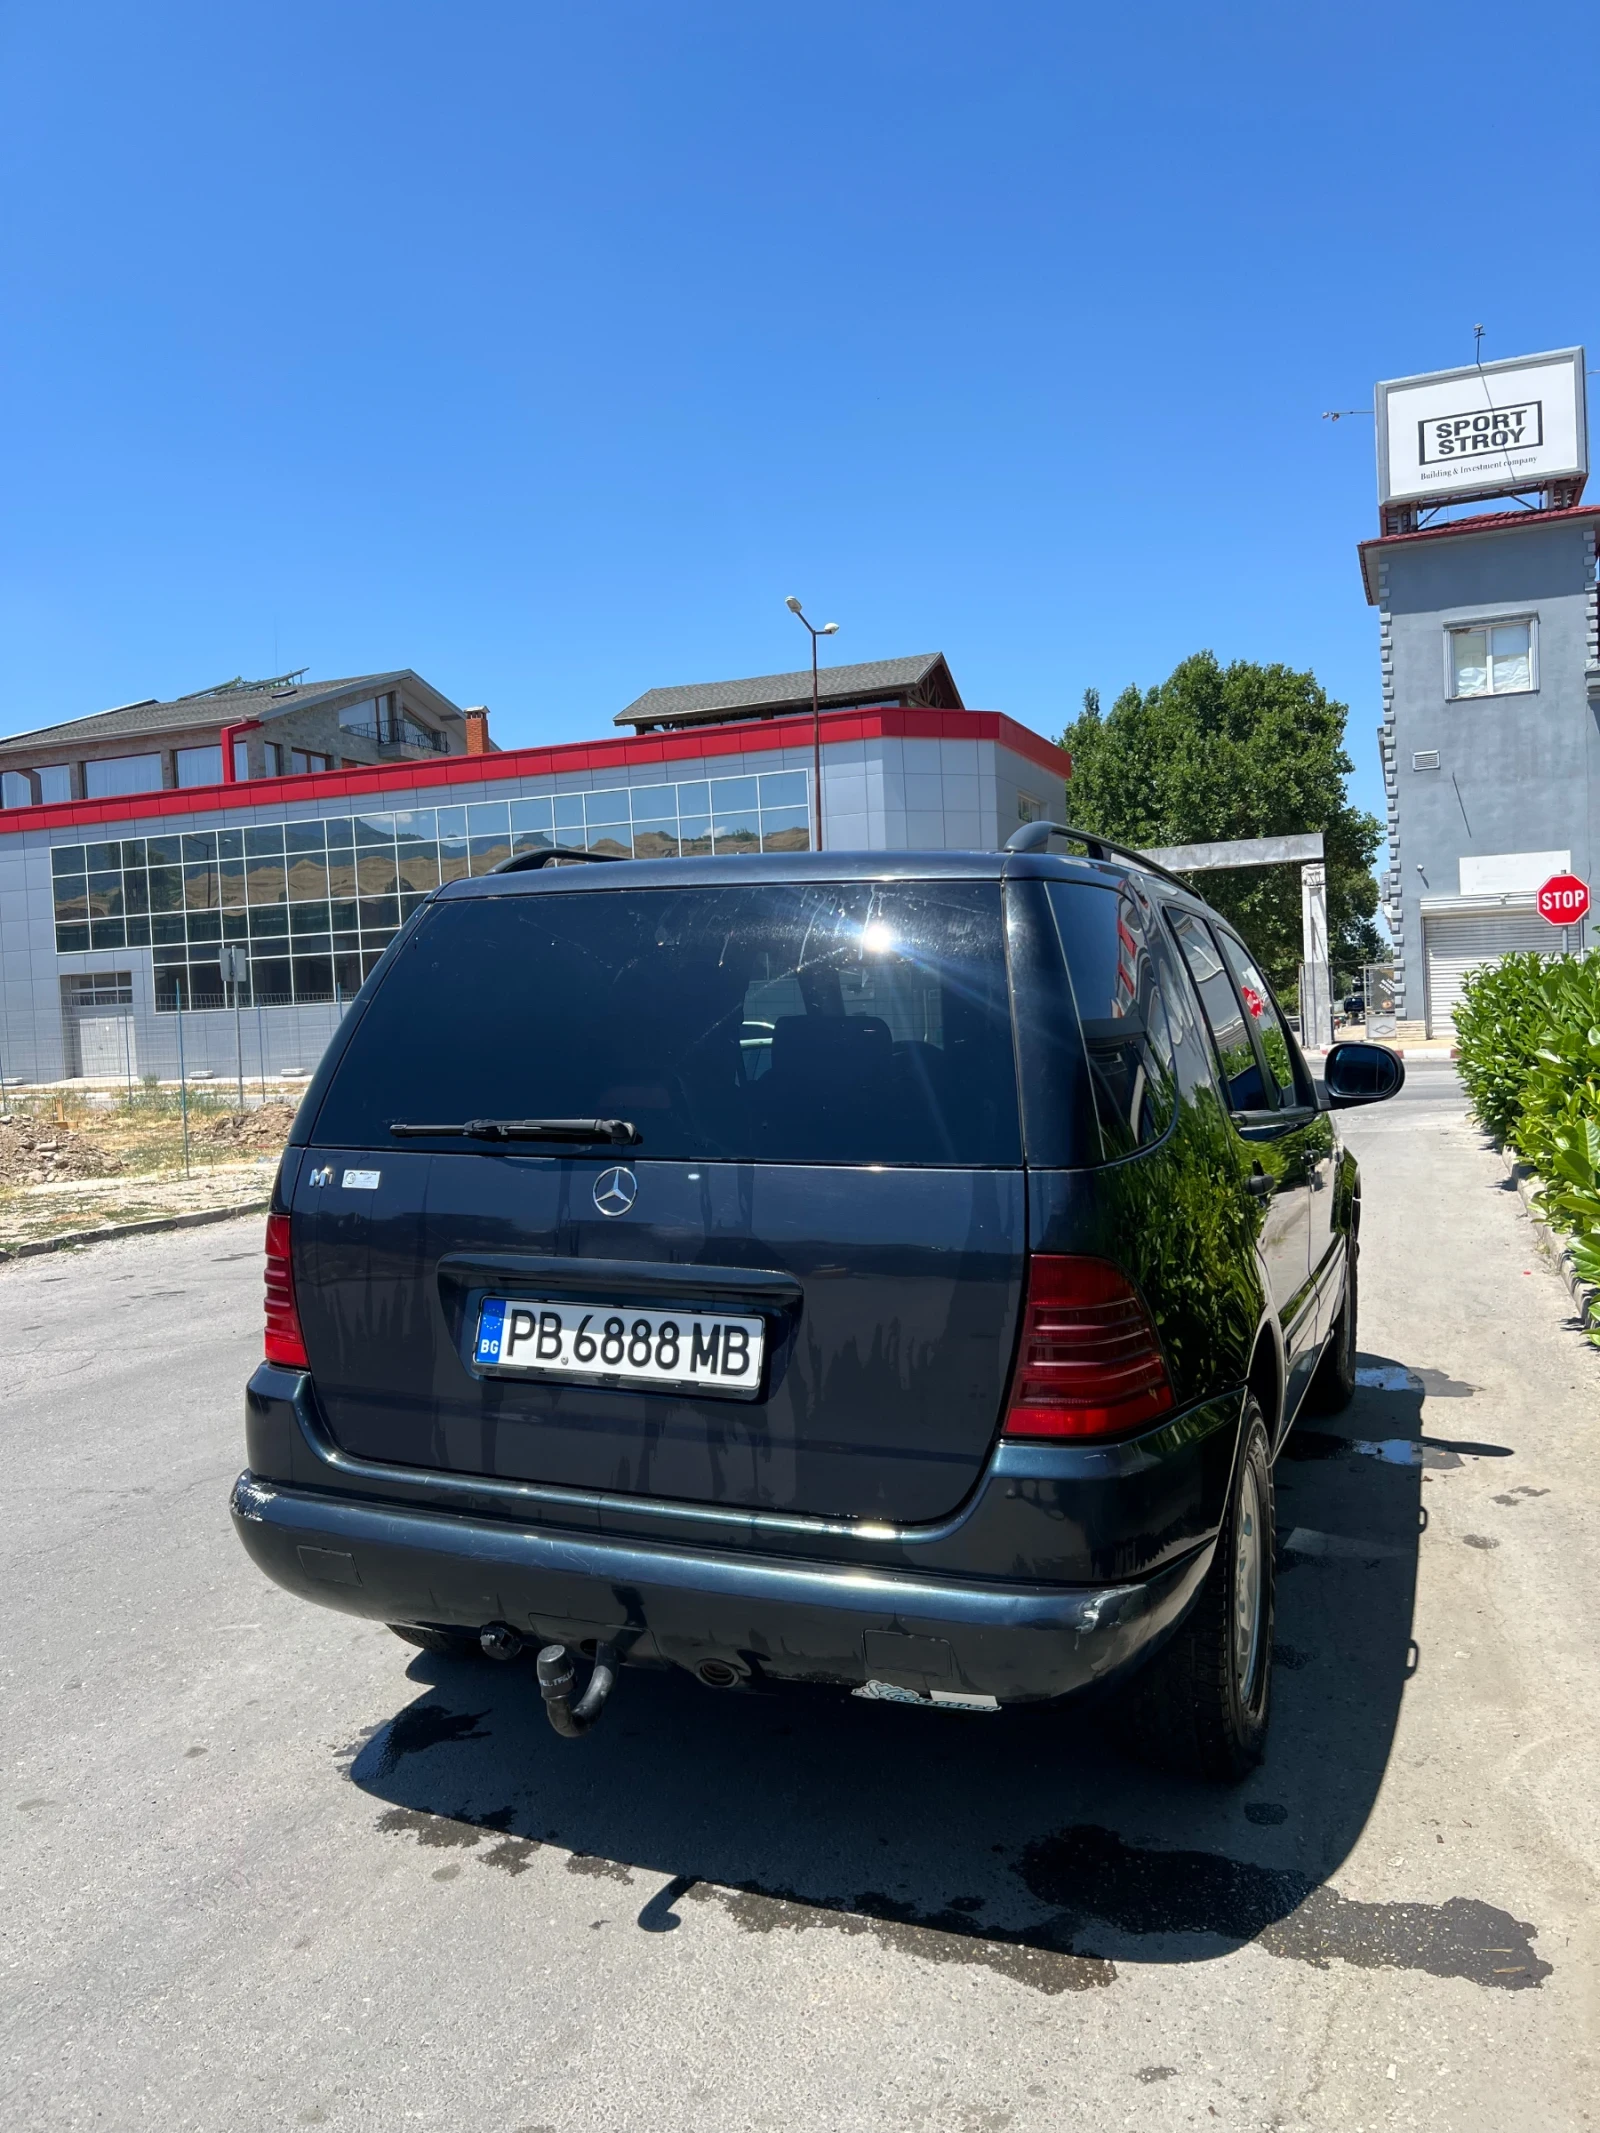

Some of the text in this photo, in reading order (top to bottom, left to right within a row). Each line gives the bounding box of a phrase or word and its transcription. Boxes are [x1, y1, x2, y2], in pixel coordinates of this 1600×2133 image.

[1436, 409, 1528, 439] SPORT
[1438, 426, 1527, 455] STROY
[1420, 456, 1538, 481] Building & Investment company
[1541, 889, 1585, 911] STOP
[480, 1338, 500, 1355] BG
[506, 1308, 751, 1377] PB 6888 MB
